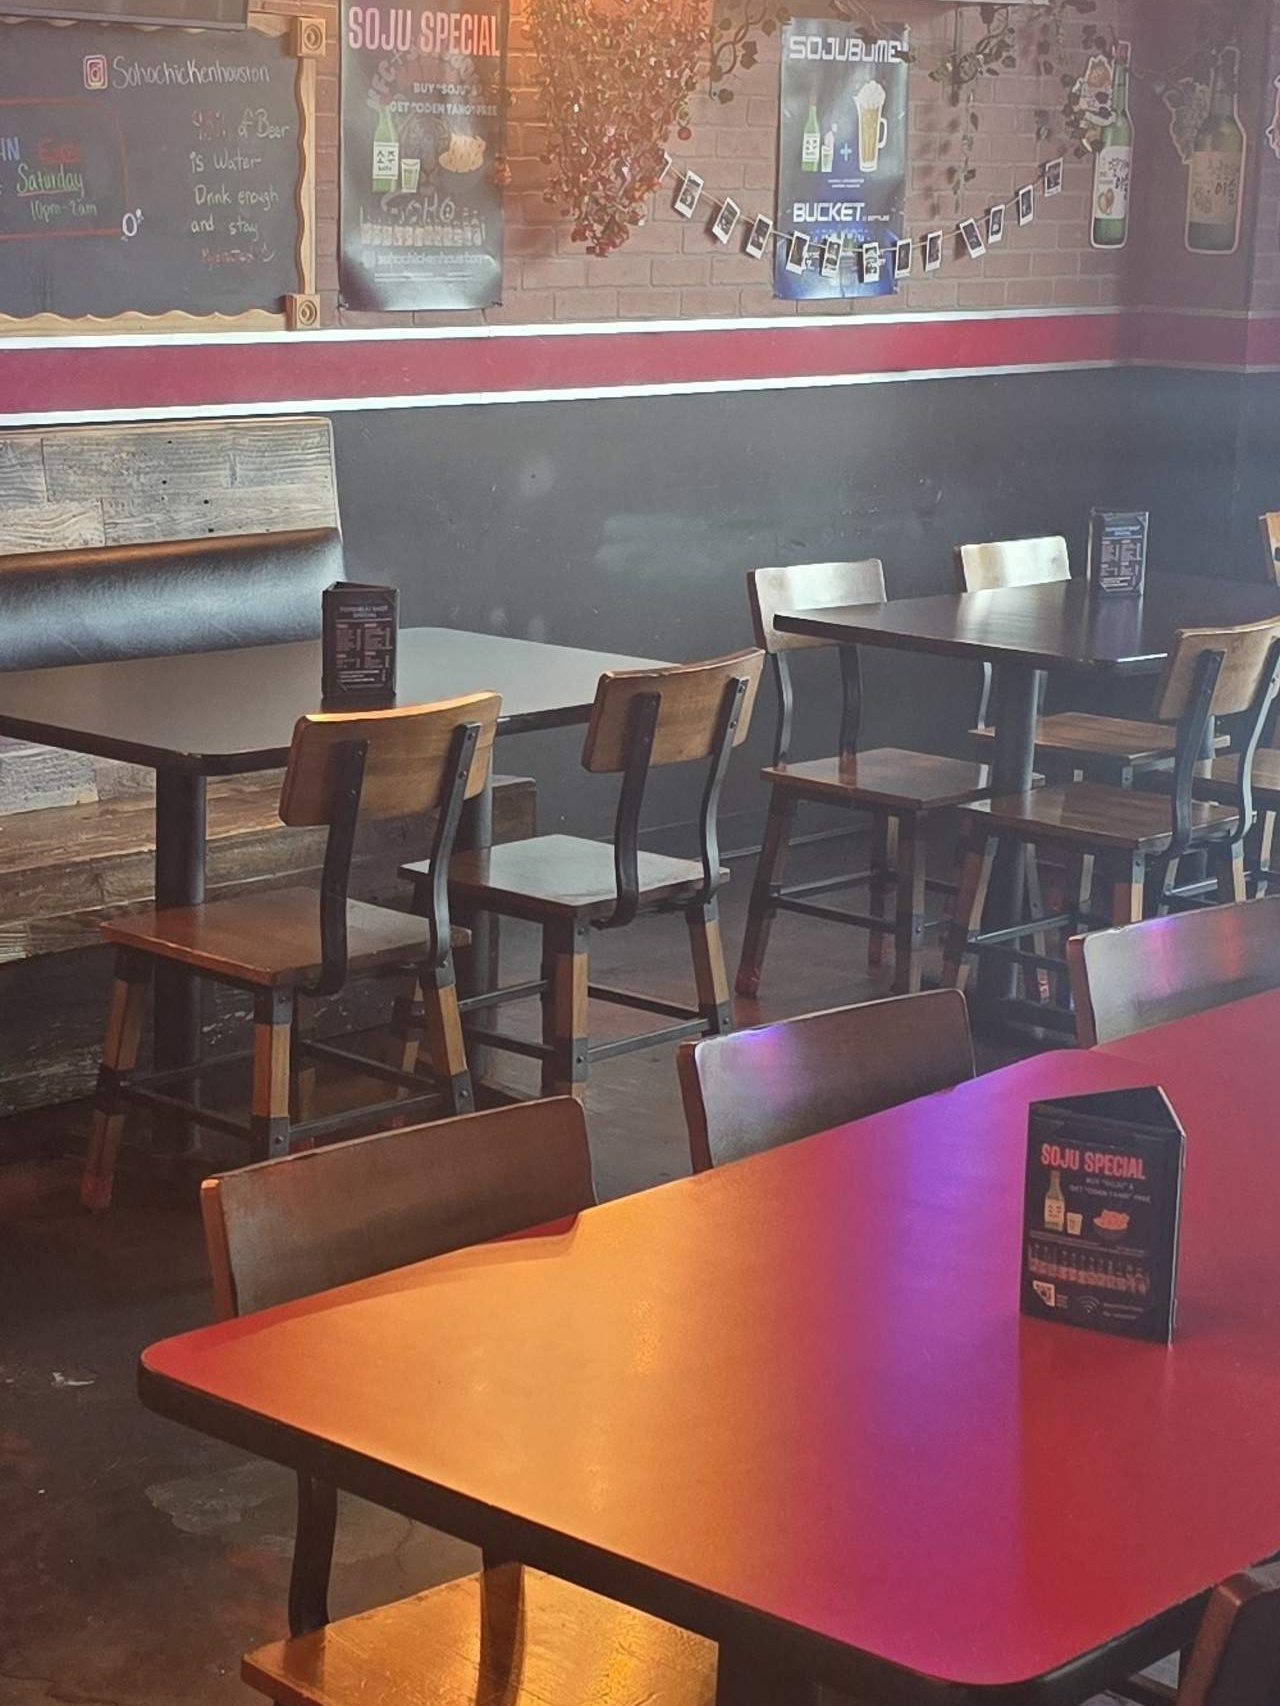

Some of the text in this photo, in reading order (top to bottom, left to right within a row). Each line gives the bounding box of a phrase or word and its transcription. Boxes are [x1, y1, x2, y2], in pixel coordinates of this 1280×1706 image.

[348, 6, 501, 56] SOJU SPECIAL
[254, 108, 291, 139] Beer
[189, 150, 205, 174] is
[15, 162, 86, 200] Saturday
[194, 183, 233, 206] Drink
[793, 202, 866, 223] BUCKET
[191, 214, 261, 243] and stay
[1041, 1144, 1146, 1181] SOJU SPECIAL
